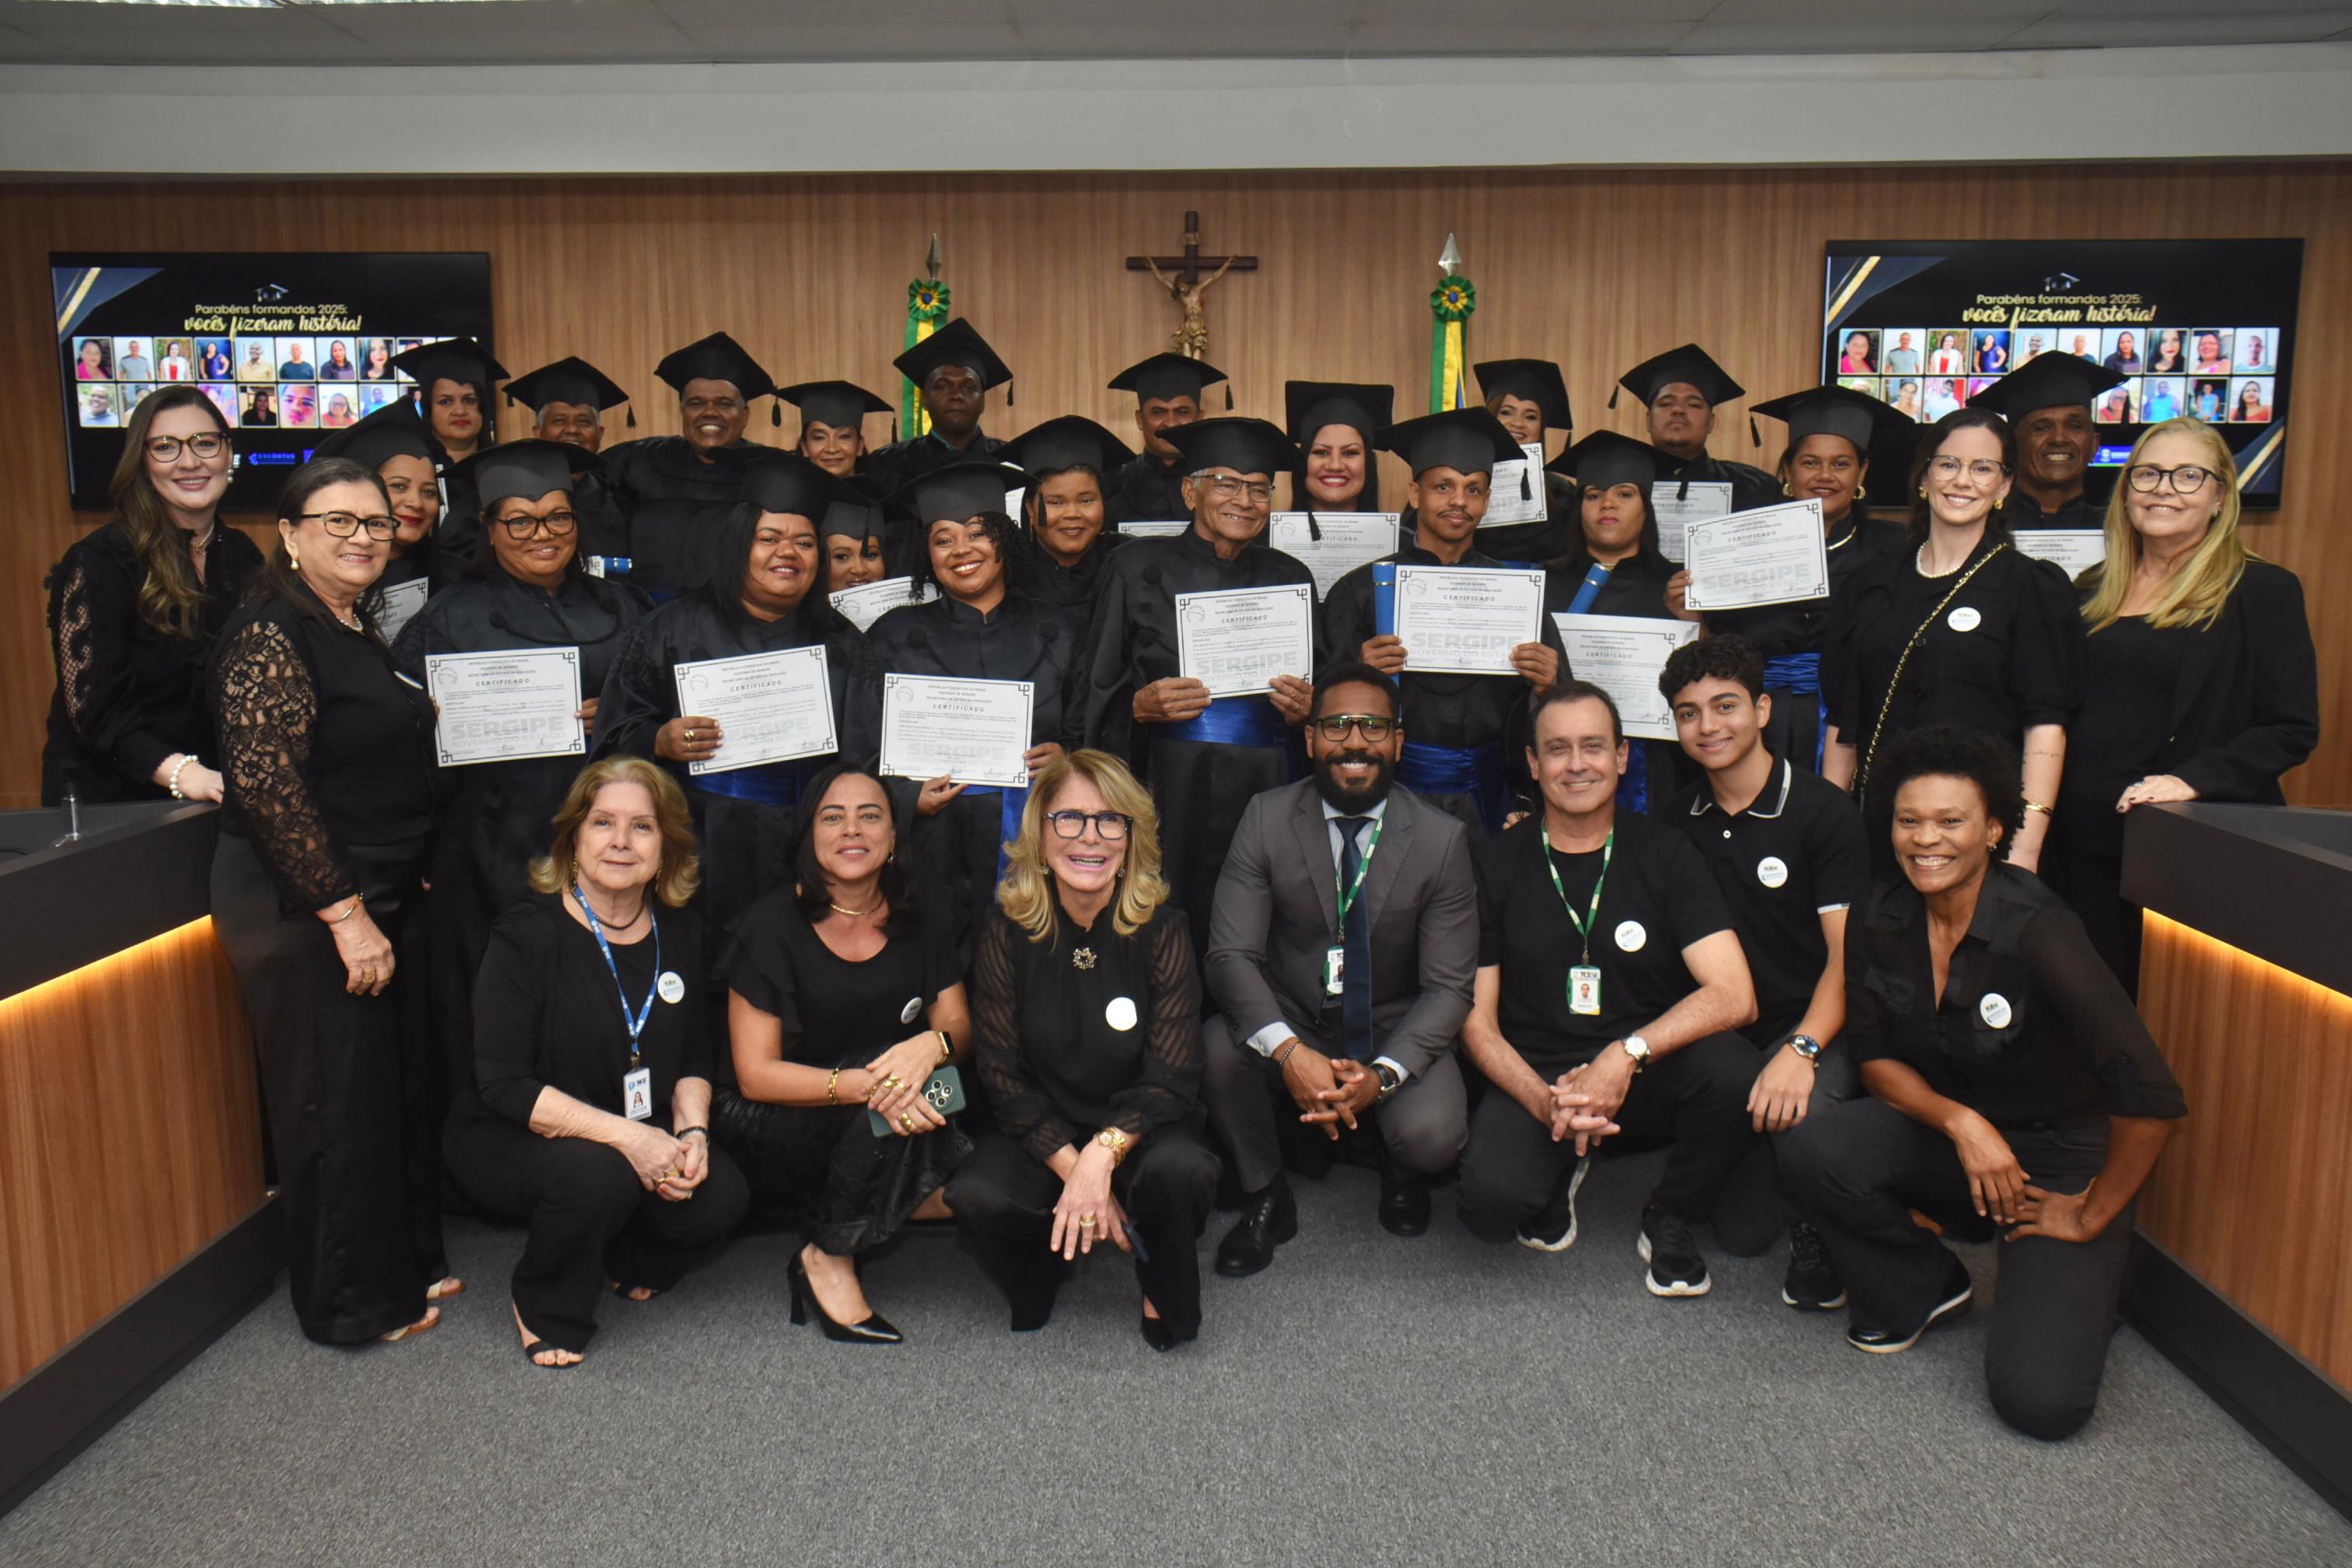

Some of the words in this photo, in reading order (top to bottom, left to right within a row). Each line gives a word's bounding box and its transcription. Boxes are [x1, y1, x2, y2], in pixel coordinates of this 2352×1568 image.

[1976, 294, 2035, 305] Parabéns
[2039, 293, 2107, 304] formandos
[2109, 293, 2143, 304] 2025:
[195, 304, 250, 314] Parabéns
[252, 304, 315, 314] formandos
[318, 304, 348, 314] 2025:
[1962, 305, 2009, 323] vocês
[2009, 306, 2082, 334] fizeram
[2085, 303, 2157, 323] história!
[184, 314, 226, 331] vocês
[229, 315, 294, 342] fizeram
[299, 312, 362, 331] história!
[1727, 530, 1776, 542] CERTIFICADO
[1702, 562, 1810, 590] SERGIPE
[1221, 614, 1268, 623] CERTIFICADO
[1195, 652, 1297, 676] SERGIPE
[476, 678, 530, 687] CERTIFICADO
[730, 680, 782, 692] CERTIFICADO
[933, 704, 985, 712] CERTIFICADO
[450, 716, 565, 740] SERGIPE
[727, 716, 810, 743] ERGIPE
[907, 742, 1006, 761] SERGIPE
